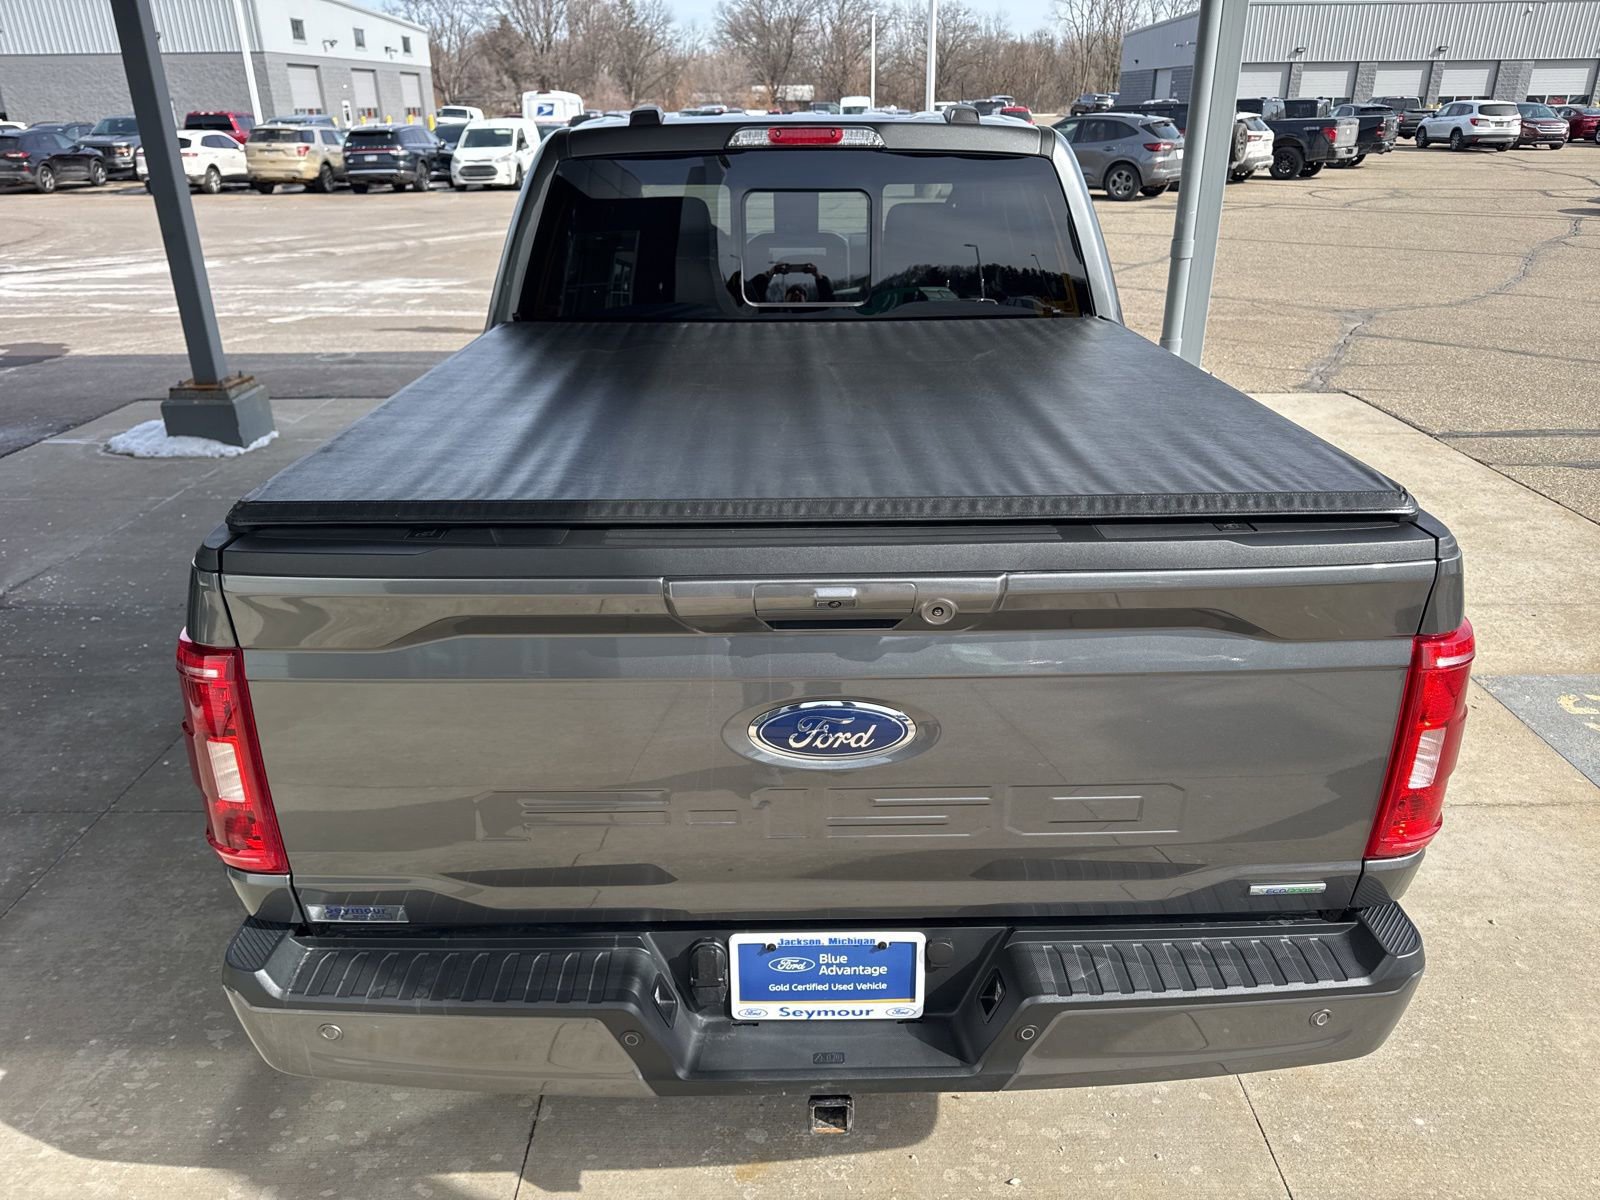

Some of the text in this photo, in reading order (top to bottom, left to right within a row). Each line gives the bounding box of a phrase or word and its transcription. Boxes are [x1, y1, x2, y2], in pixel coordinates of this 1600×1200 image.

[788, 716, 877, 749] Ford
[828, 937, 876, 946] Michigan
[777, 958, 807, 971] Ford
[819, 953, 848, 964] Blue
[818, 965, 888, 977] Advantage
[768, 981, 888, 992] Gold Certified Used Vehicle
[778, 1006, 874, 1019] Seymour
